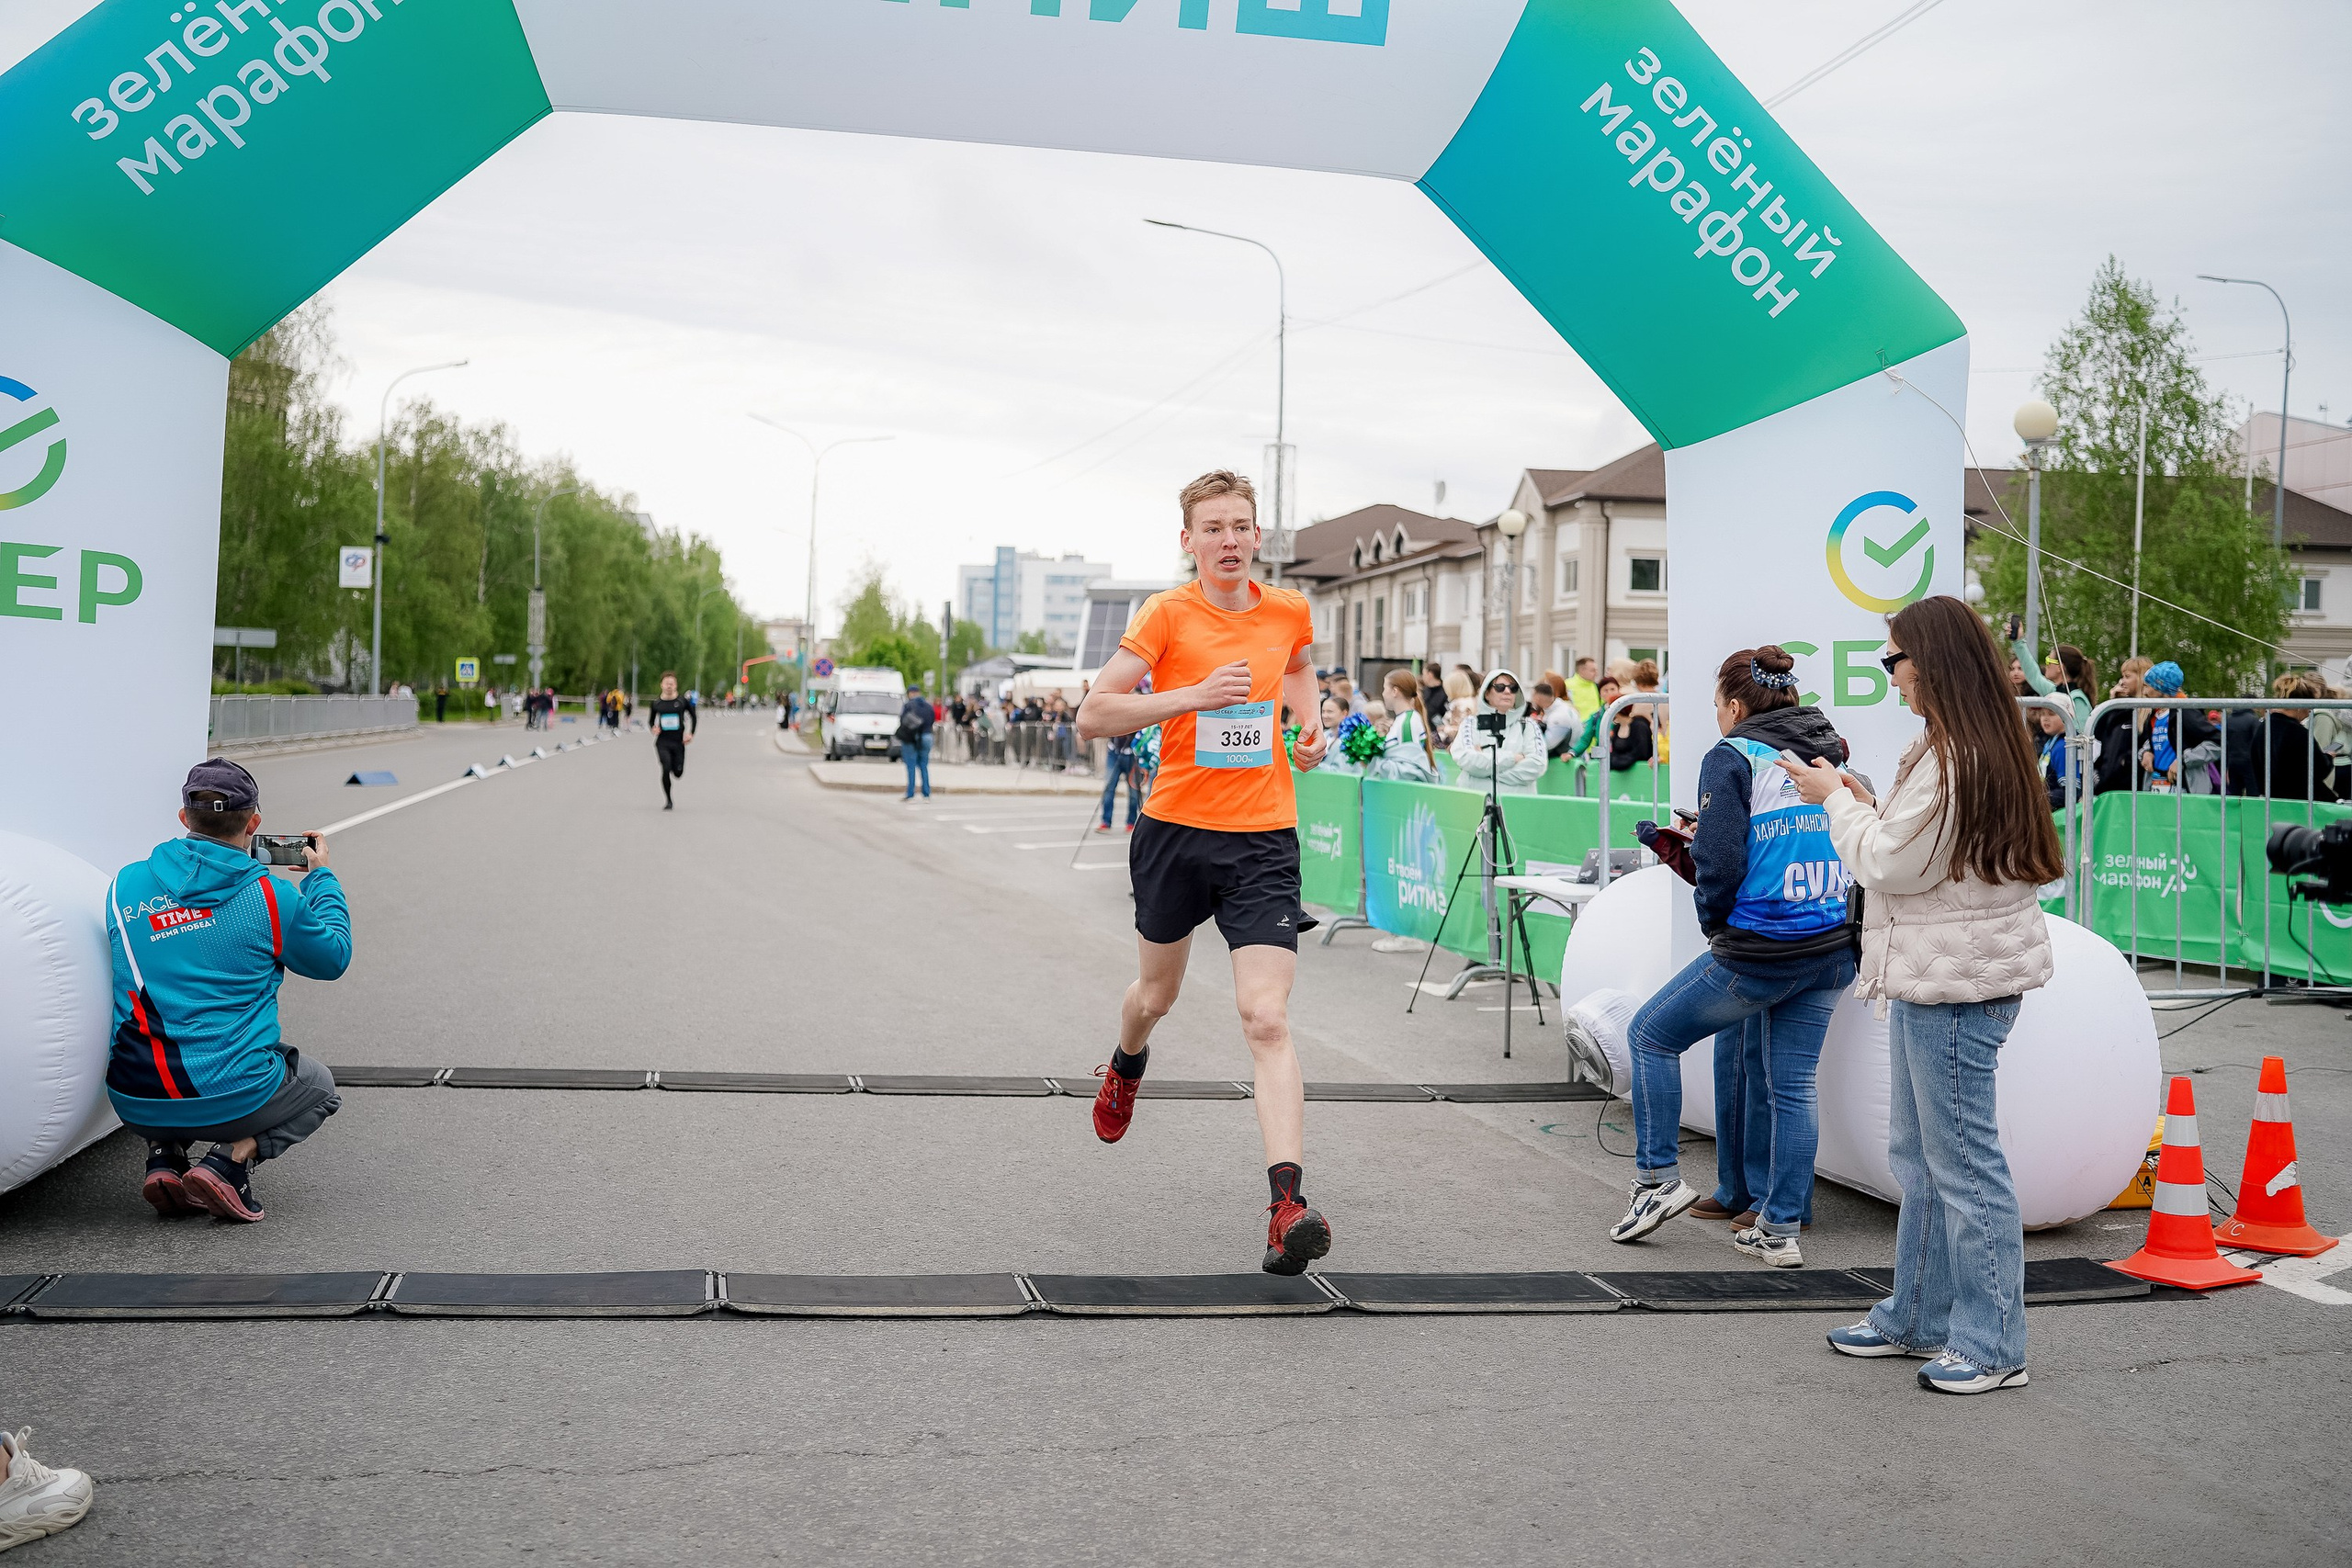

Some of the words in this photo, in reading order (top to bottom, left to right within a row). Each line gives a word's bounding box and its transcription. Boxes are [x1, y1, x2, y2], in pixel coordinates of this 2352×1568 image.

[71, 0, 284, 141] зелён
[1624, 46, 1843, 279] зелёный
[1579, 81, 1801, 319] марафон
[1220, 730, 1261, 747] 3368
[1226, 754, 1253, 764] 1000м
[1753, 810, 1831, 843] ХАНТЫ-МАНСИЙ
[122, 894, 180, 923] RACE
[156, 908, 203, 928] TIME
[149, 928, 179, 942] ВРЕМЯ
